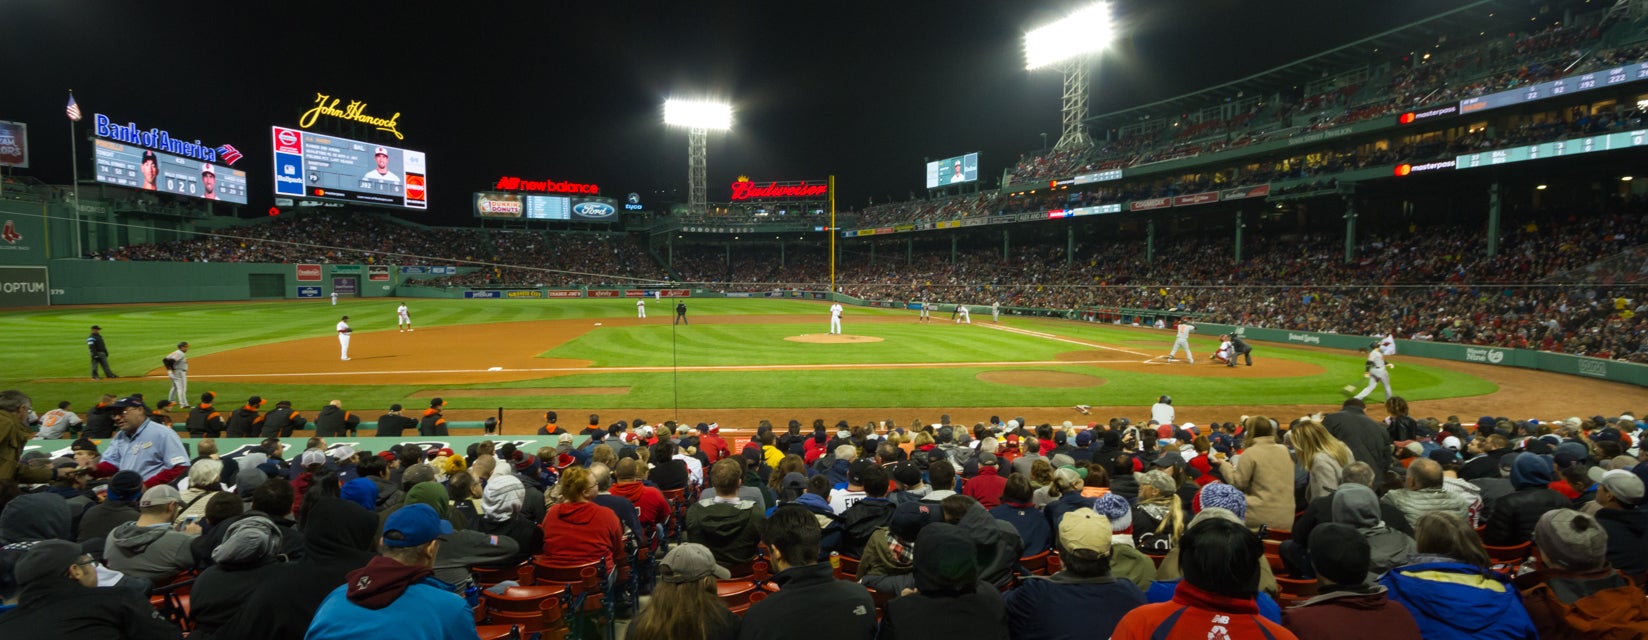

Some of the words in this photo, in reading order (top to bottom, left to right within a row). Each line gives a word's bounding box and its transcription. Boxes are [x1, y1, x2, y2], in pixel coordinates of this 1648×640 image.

[1527, 91, 1538, 100] 22
[300, 92, 344, 128] John
[344, 99, 404, 140] Hancock
[1415, 106, 1456, 119] masterpass
[95, 113, 141, 145] Bank
[142, 128, 158, 149] of
[160, 131, 217, 162] America
[1411, 160, 1456, 172] masterpass
[167, 179, 174, 190] 0
[179, 182, 185, 192] 2
[190, 183, 196, 194] 0
[520, 180, 546, 192] new
[547, 179, 599, 194] balance
[731, 180, 827, 200] Budweiser
[581, 205, 607, 215] Ford
[3, 282, 45, 293] OPTUM
